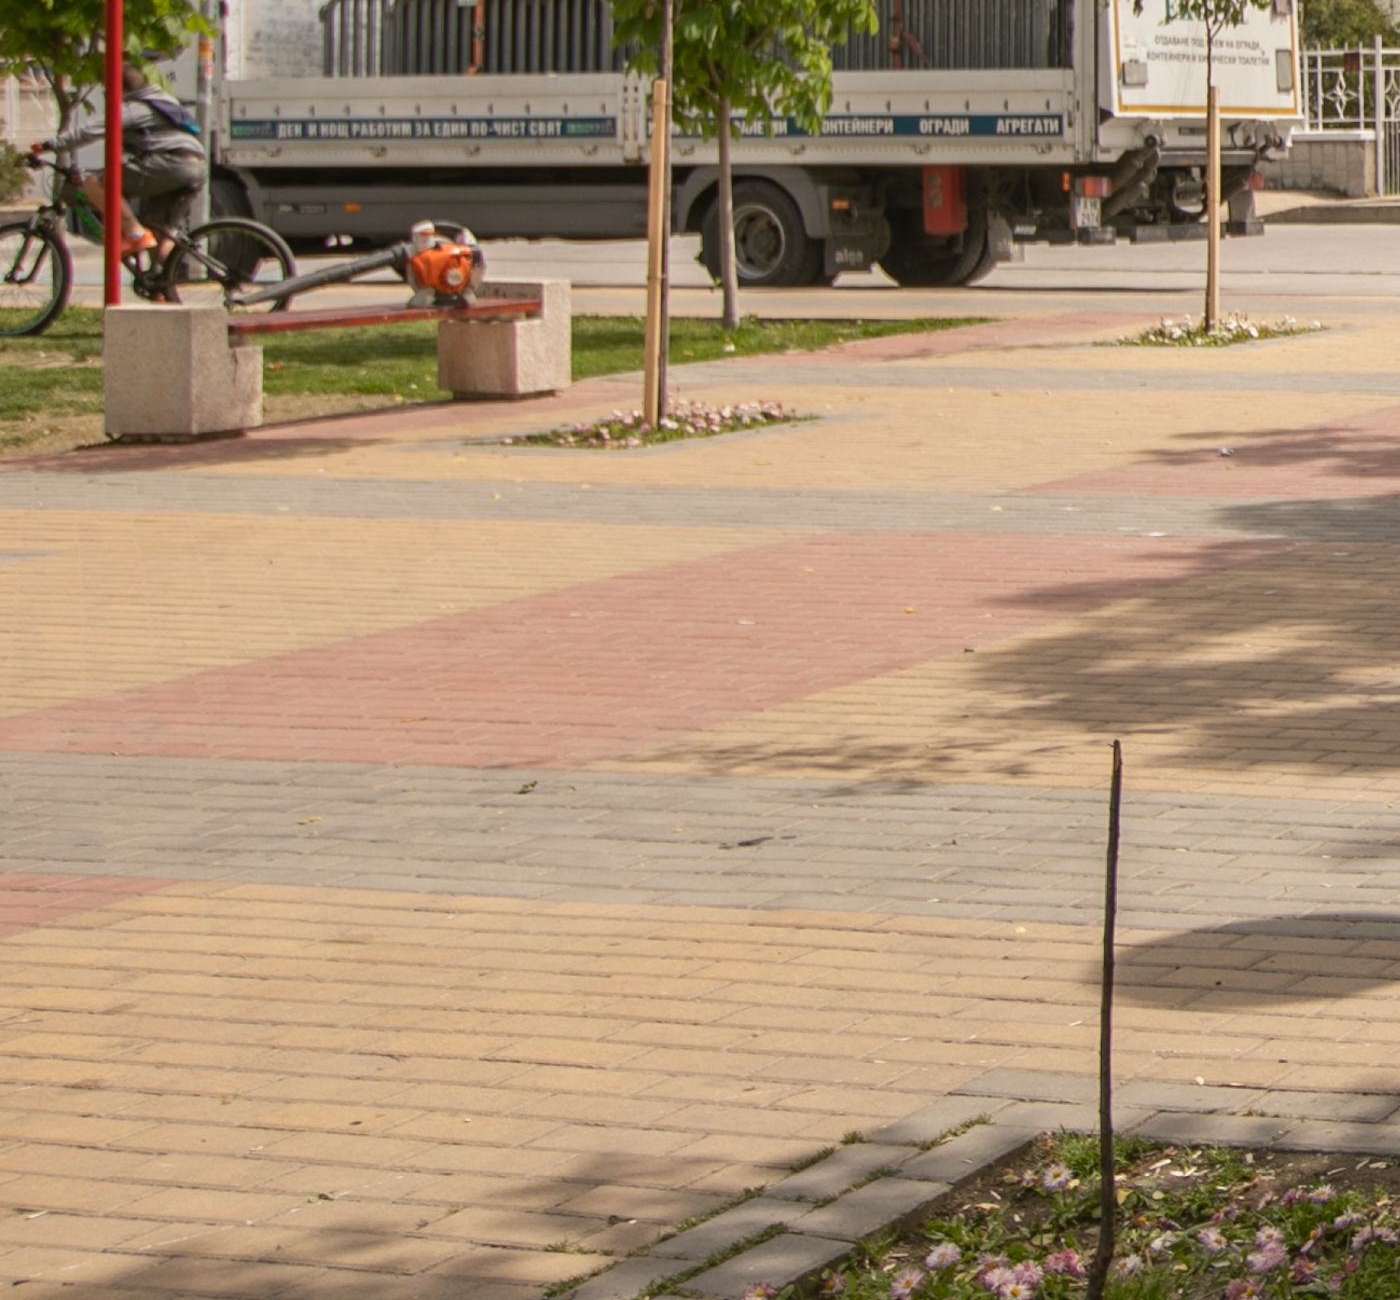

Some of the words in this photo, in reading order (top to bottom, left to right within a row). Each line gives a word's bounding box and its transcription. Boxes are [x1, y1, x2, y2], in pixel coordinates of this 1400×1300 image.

[1154, 35, 1189, 46] ОТДАВАНЕ
[1225, 40, 1234, 49] НА
[1198, 53, 1237, 65] ХИИЧЕСКИ
[278, 122, 303, 139] ДЕН
[307, 123, 317, 138] И
[321, 123, 350, 139] НОЩ
[352, 122, 412, 138] РАБОТИМ
[414, 122, 431, 137] ЗА
[434, 122, 468, 138] ЕДИН
[471, 121, 526, 137] ПО-ЧИСТ
[529, 121, 562, 136] СВЯТ
[809, 118, 894, 135] ОНТЕЙНЕРИ
[919, 118, 970, 136] ОГРАДИ
[996, 117, 1060, 134] АГРЕГАТИ
